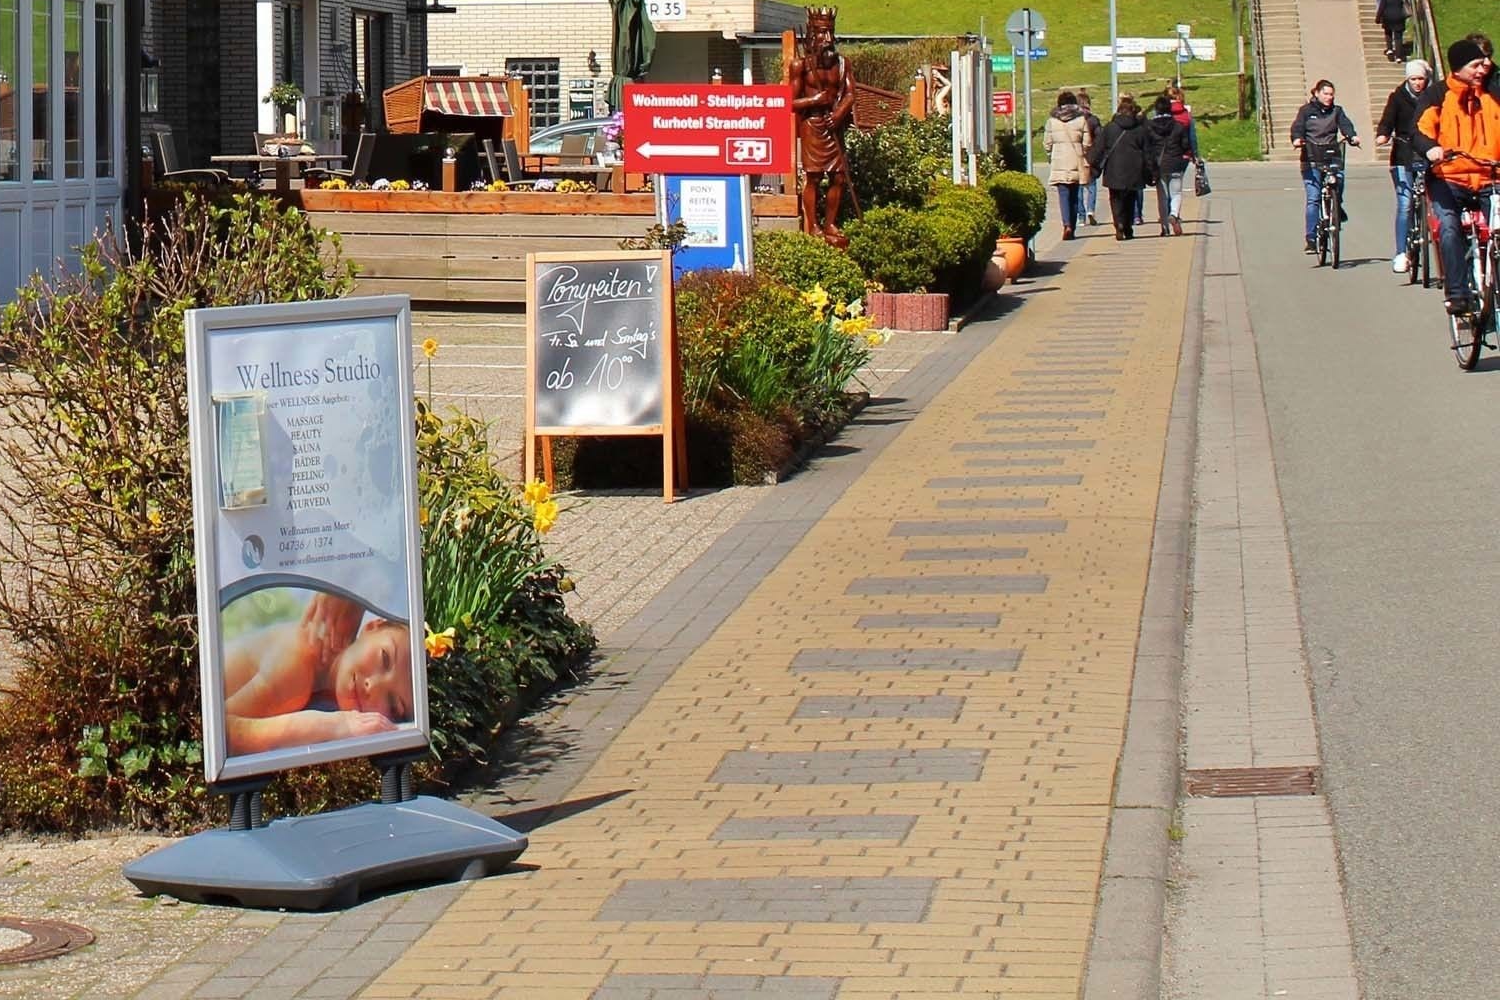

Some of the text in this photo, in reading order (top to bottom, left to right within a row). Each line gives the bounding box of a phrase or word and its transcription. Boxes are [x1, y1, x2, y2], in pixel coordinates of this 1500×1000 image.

[664, 2, 682, 16] 35
[632, 93, 698, 108] Wohnmobil
[707, 93, 764, 110] Stellplatz
[766, 96, 785, 108] am
[652, 116, 766, 130] Kurhotel Strandhof
[584, 330, 608, 347] und
[236, 354, 381, 390] Wellness Studio
[546, 357, 574, 390] ab
[279, 396, 320, 409] WELLNESS
[286, 414, 324, 427] MASSAGE
[290, 428, 322, 441] BEAUTY
[292, 441, 321, 455] SAUNA
[294, 455, 321, 469] BÄDER
[292, 469, 325, 482] PEELING
[287, 482, 330, 497] THALASSO
[286, 496, 332, 511] AYURVEDA
